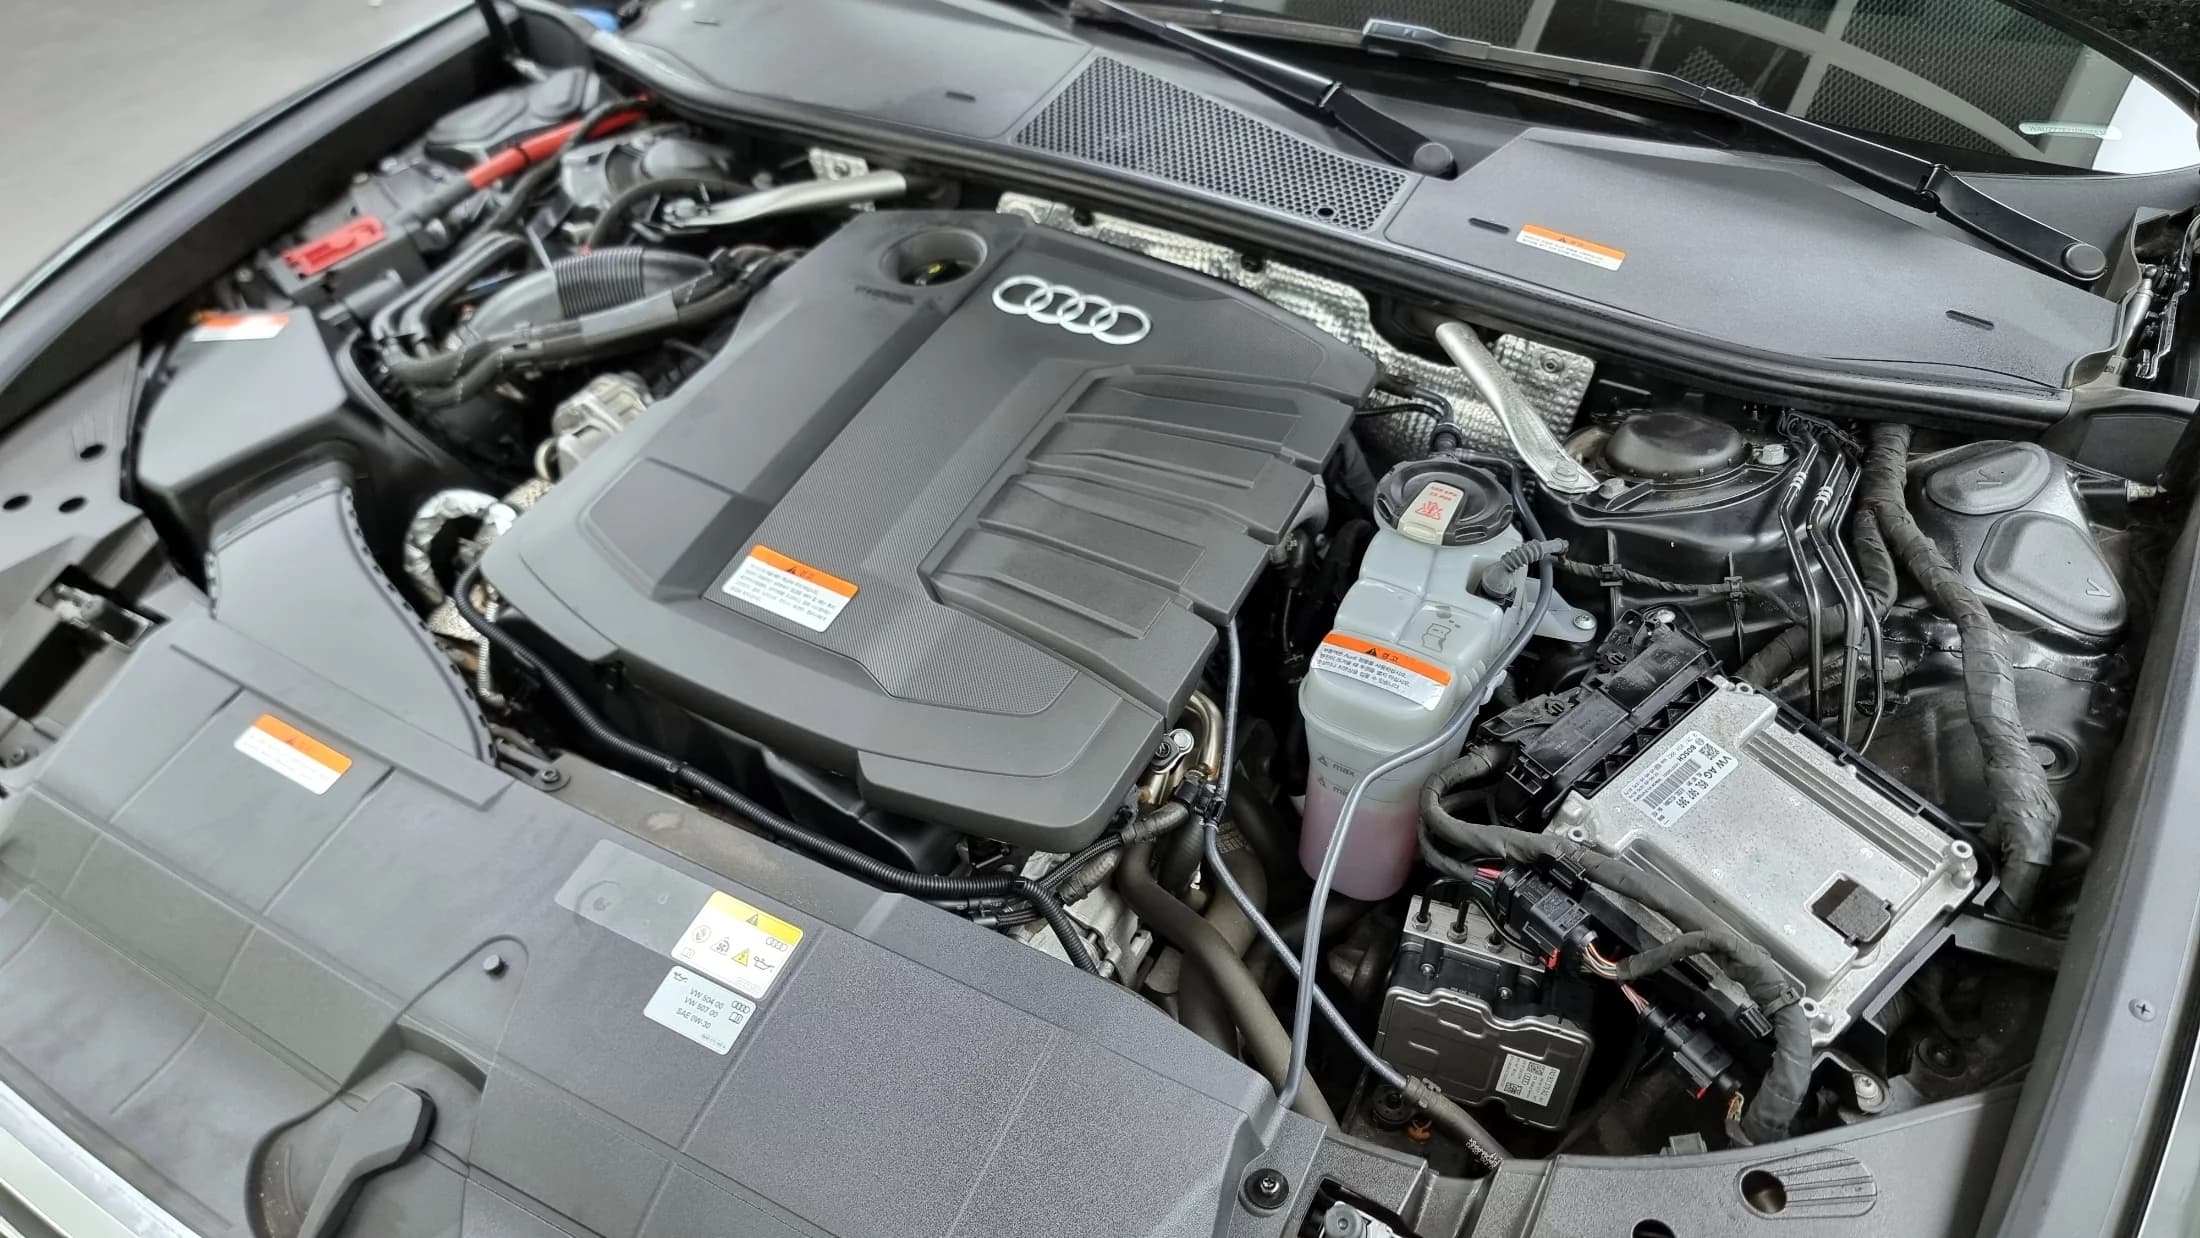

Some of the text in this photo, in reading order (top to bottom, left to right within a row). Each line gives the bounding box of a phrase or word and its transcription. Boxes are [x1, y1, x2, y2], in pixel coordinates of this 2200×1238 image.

[1677, 745, 1697, 762] BOSCH
[1715, 755, 1732, 769] VW
[1333, 764, 1354, 777] max
[1704, 767, 1717, 779] AG
[690, 987, 724, 1009] VW 504 00
[685, 997, 719, 1018] VW 507 00
[676, 1008, 711, 1029] SAE 0W-30
